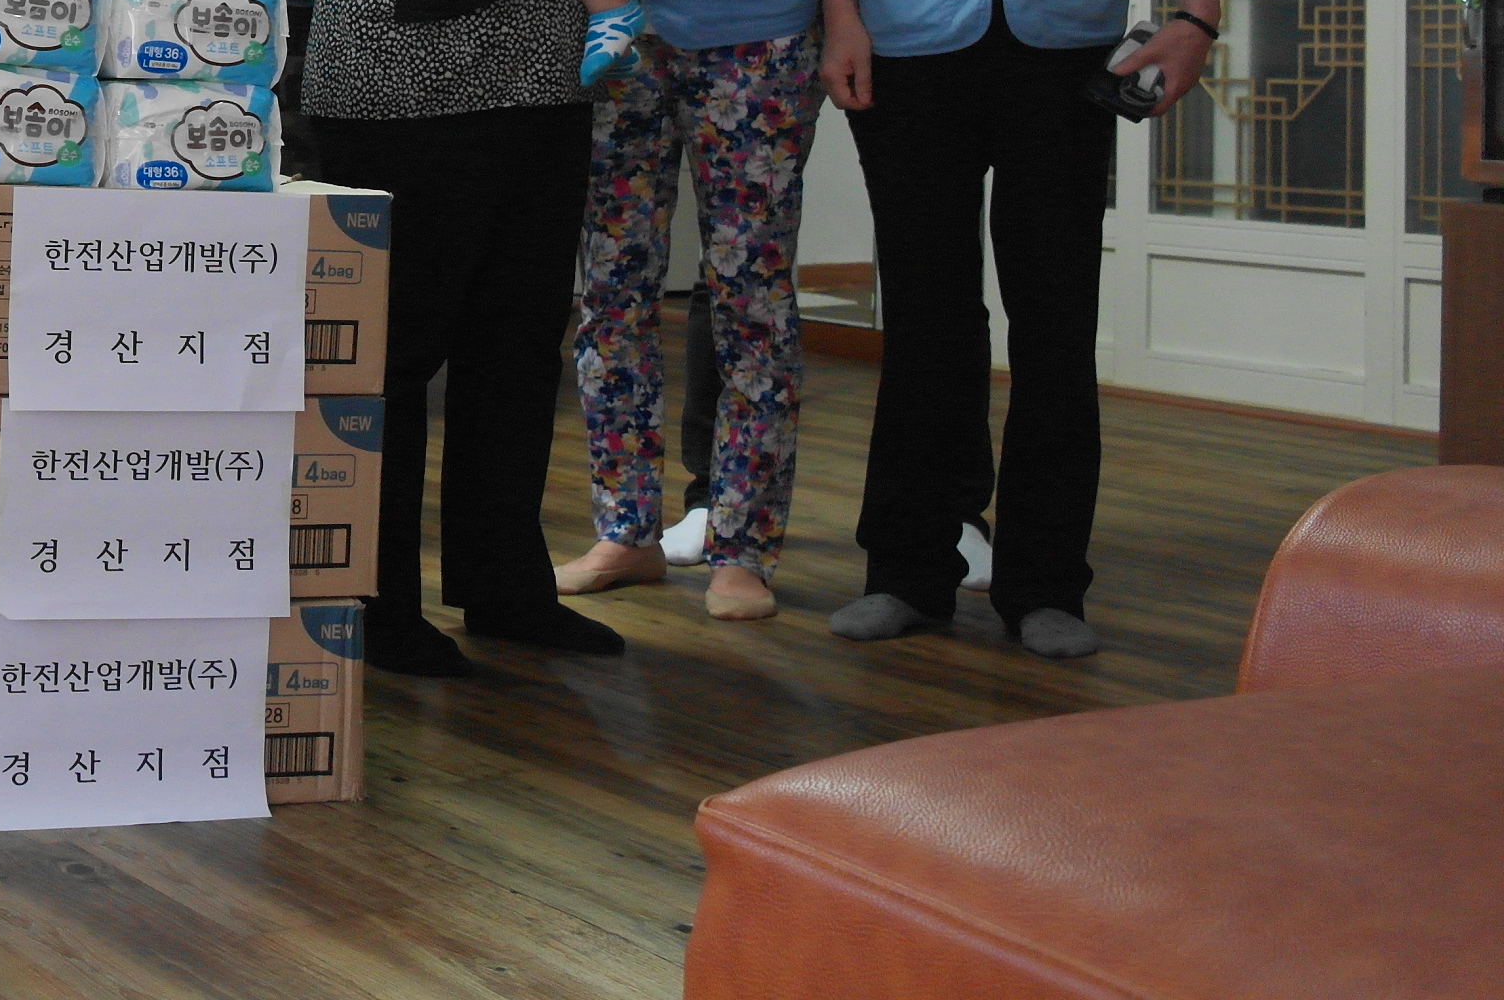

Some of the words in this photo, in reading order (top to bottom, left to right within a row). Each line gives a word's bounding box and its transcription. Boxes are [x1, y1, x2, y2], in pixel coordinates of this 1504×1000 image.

[21, 24, 57, 39] 소프트
[190, 2, 257, 38] 보솜이
[145, 46, 163, 58] 대형
[165, 47, 179, 60] 36
[1, 102, 71, 138] 보솜이
[187, 116, 252, 151] 보솜이
[144, 167, 163, 178] 대형
[164, 166, 178, 177] 36
[347, 212, 380, 228] NEW
[45, 239, 277, 274] 한전산업개발(주)
[45, 330, 73, 364] 경
[111, 331, 143, 363] 산
[178, 331, 204, 364] 지
[244, 332, 270, 364] 점
[339, 416, 372, 431] NEW
[32, 450, 264, 482] 한전산업개발(주)
[31, 539, 58, 573] 경
[97, 539, 128, 571] 산
[164, 539, 189, 571] 지
[229, 538, 255, 570] 점
[321, 624, 354, 639] NEW
[1, 658, 237, 693] 한전산업개발(주)
[3, 752, 30, 785] 경
[69, 750, 101, 783] 산
[137, 748, 163, 781] 지
[202, 746, 228, 778] 점
